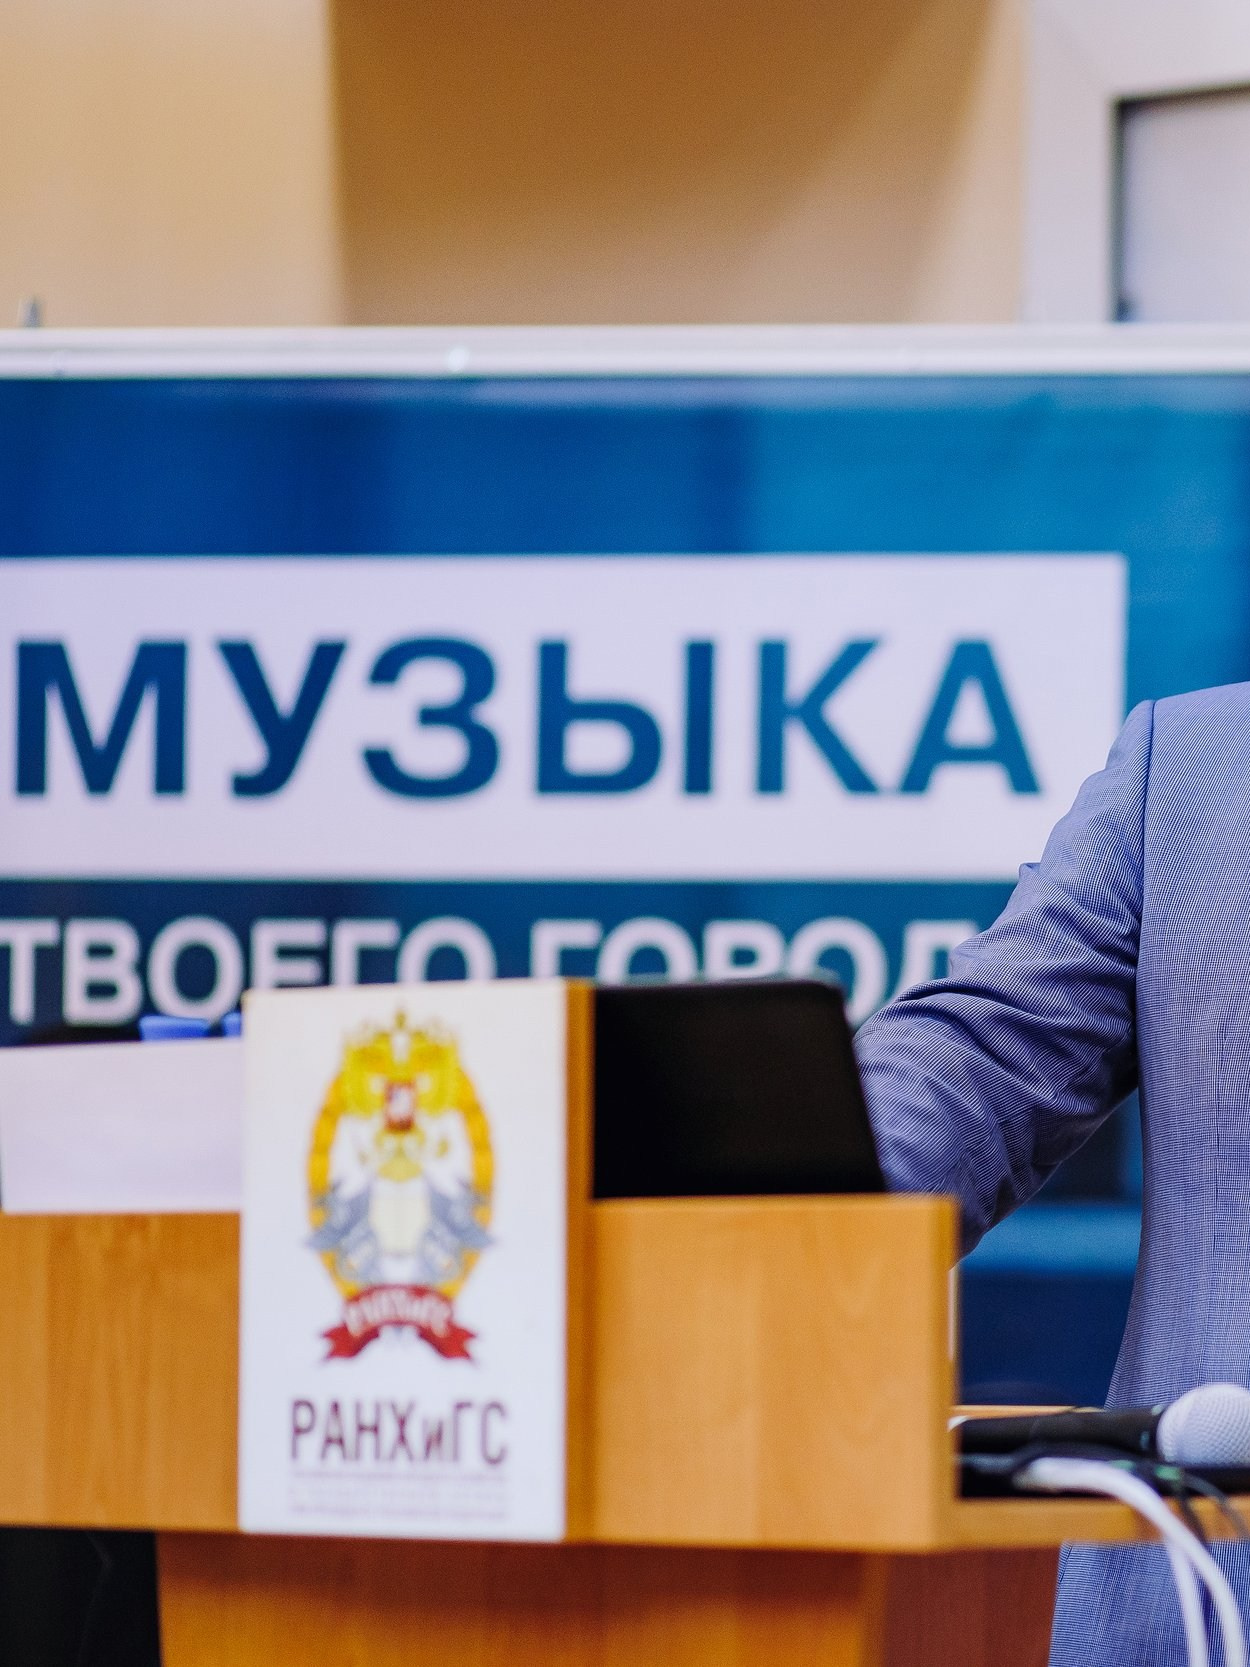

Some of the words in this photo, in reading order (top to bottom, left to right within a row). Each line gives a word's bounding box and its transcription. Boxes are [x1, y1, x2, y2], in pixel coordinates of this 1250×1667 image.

[14, 636, 1044, 799] МУЗЫКА
[0, 915, 498, 1027] ТВОЕГО
[290, 1397, 508, 1466] РАНХиГС
